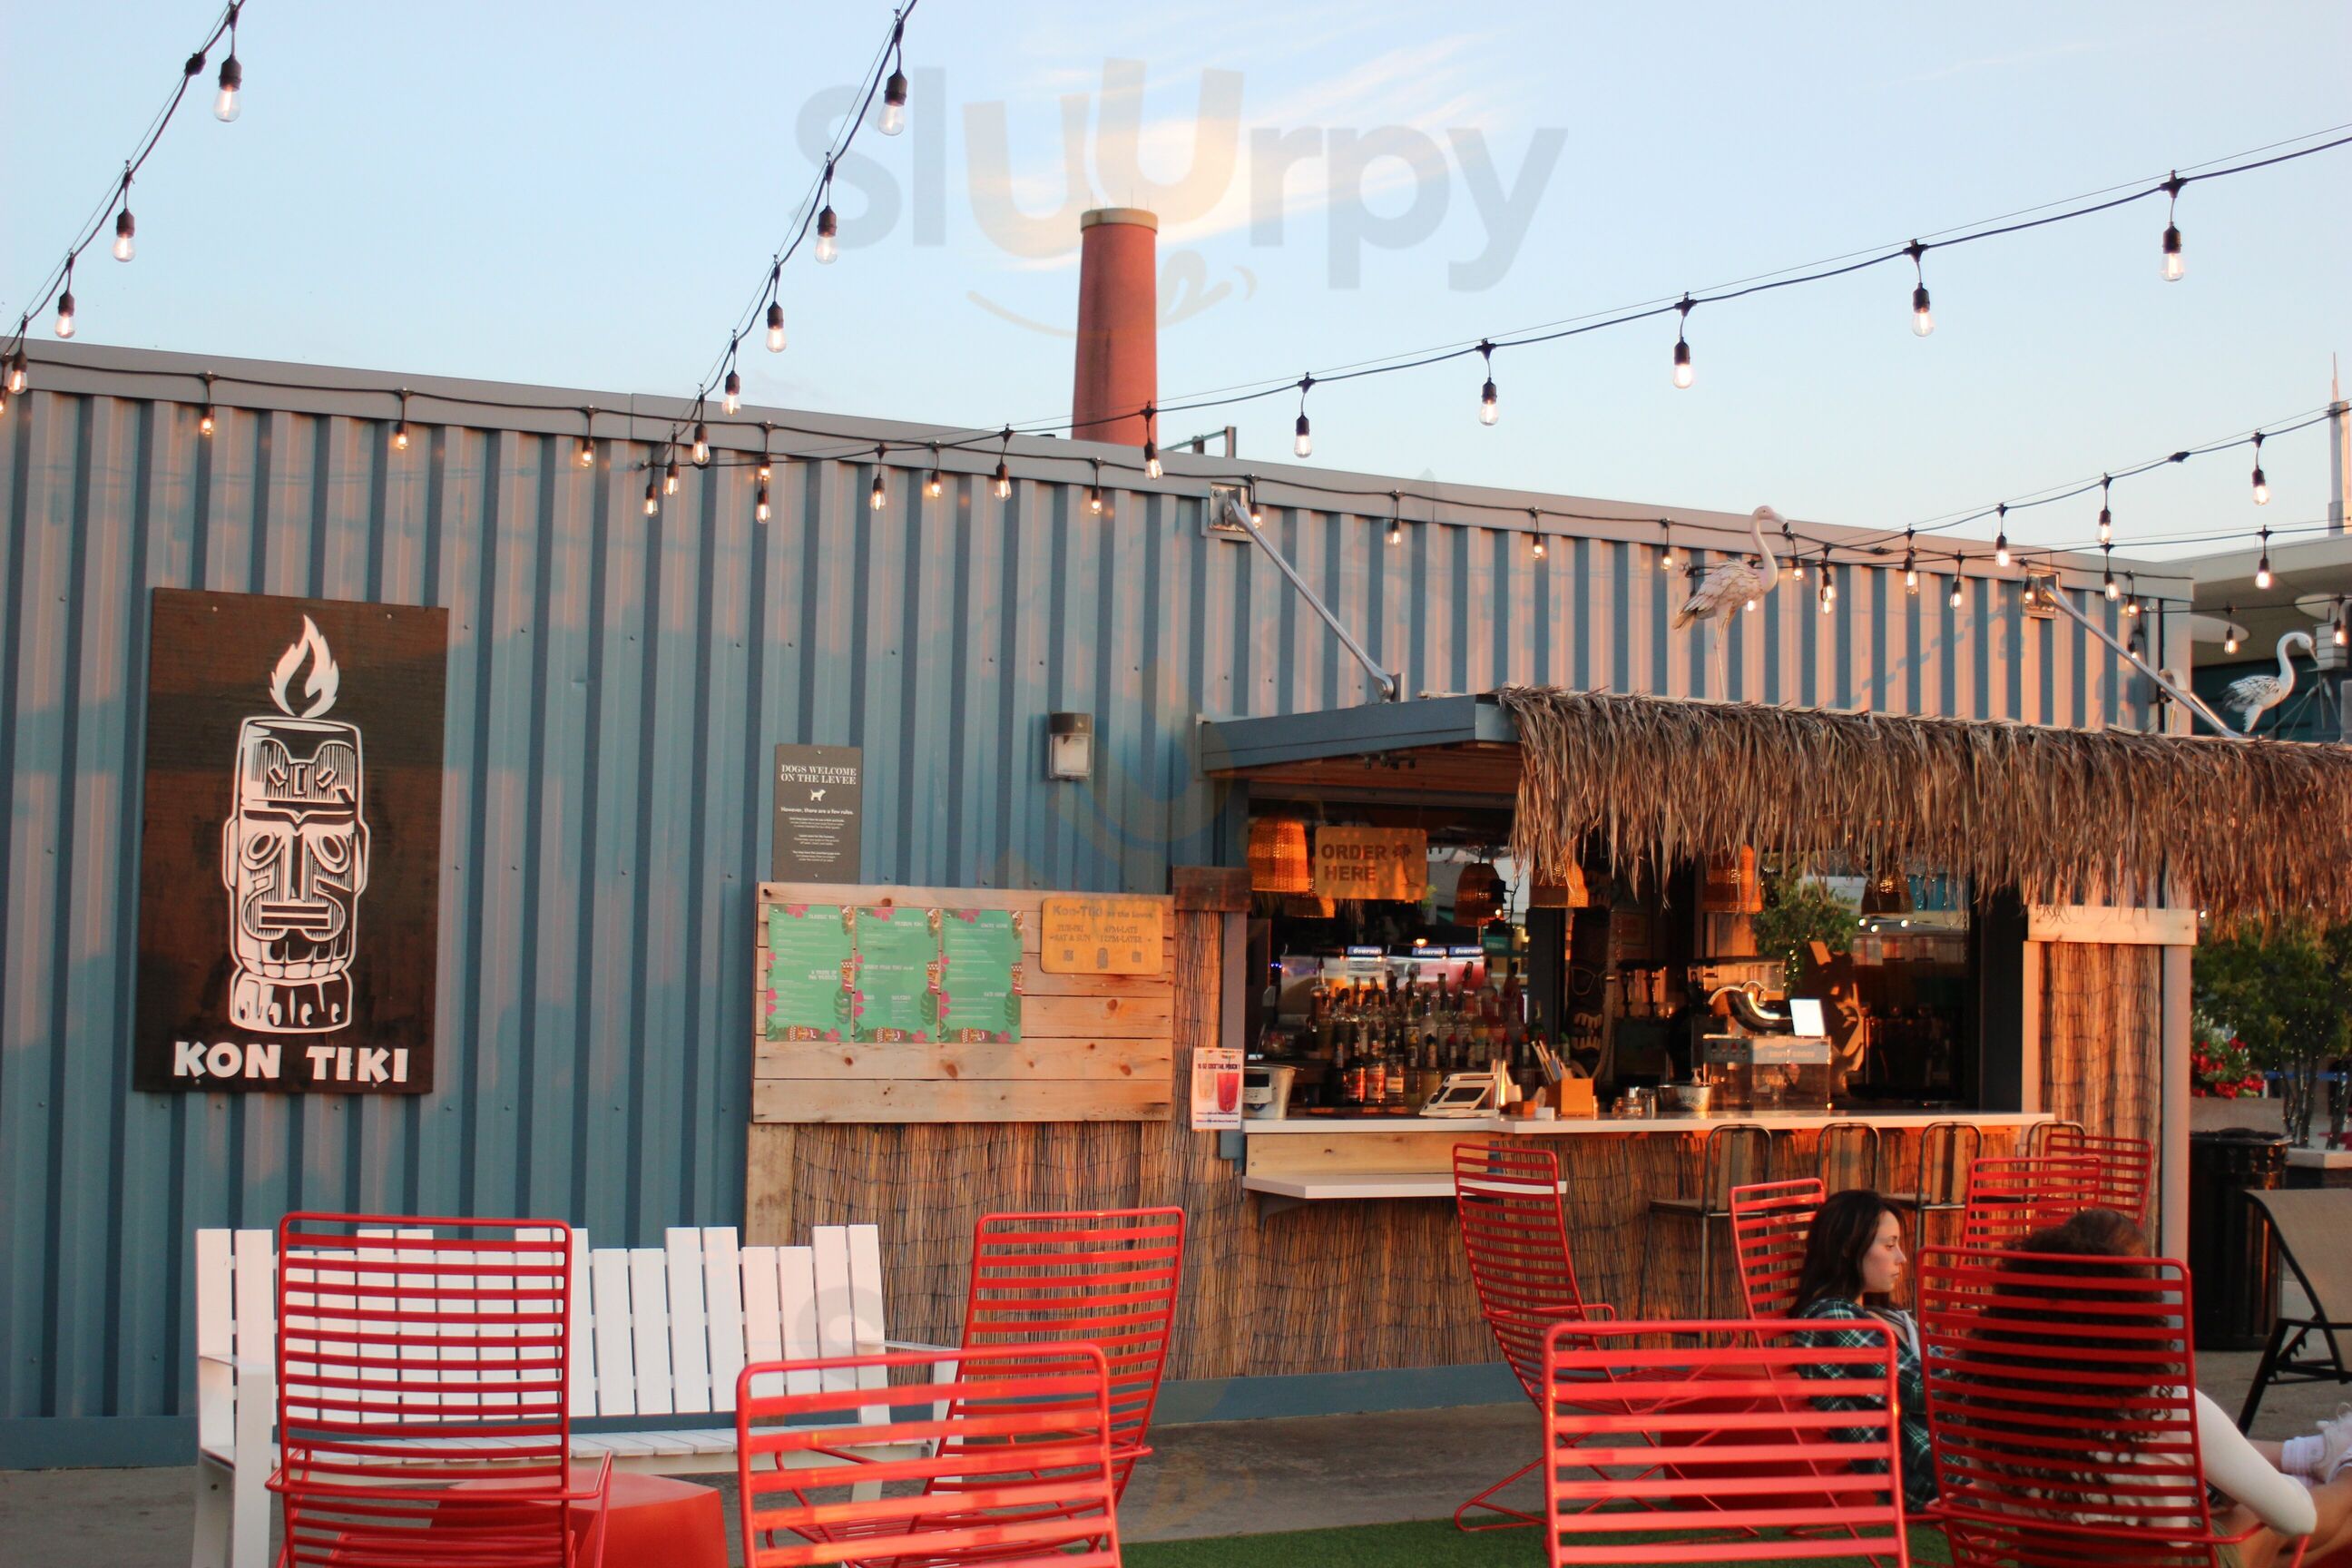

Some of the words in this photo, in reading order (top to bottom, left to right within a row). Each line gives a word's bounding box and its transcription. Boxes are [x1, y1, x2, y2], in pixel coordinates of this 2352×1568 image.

[781, 764, 807, 773] DOGS
[808, 765, 857, 776] WELCOME
[780, 773, 795, 782] ON
[798, 774, 819, 783] THE
[821, 775, 857, 785] LEVEE
[1321, 844, 1387, 860] ORDER
[1325, 866, 1377, 881] HERE
[173, 1041, 282, 1080] KON
[306, 1046, 409, 1083] TIKI
